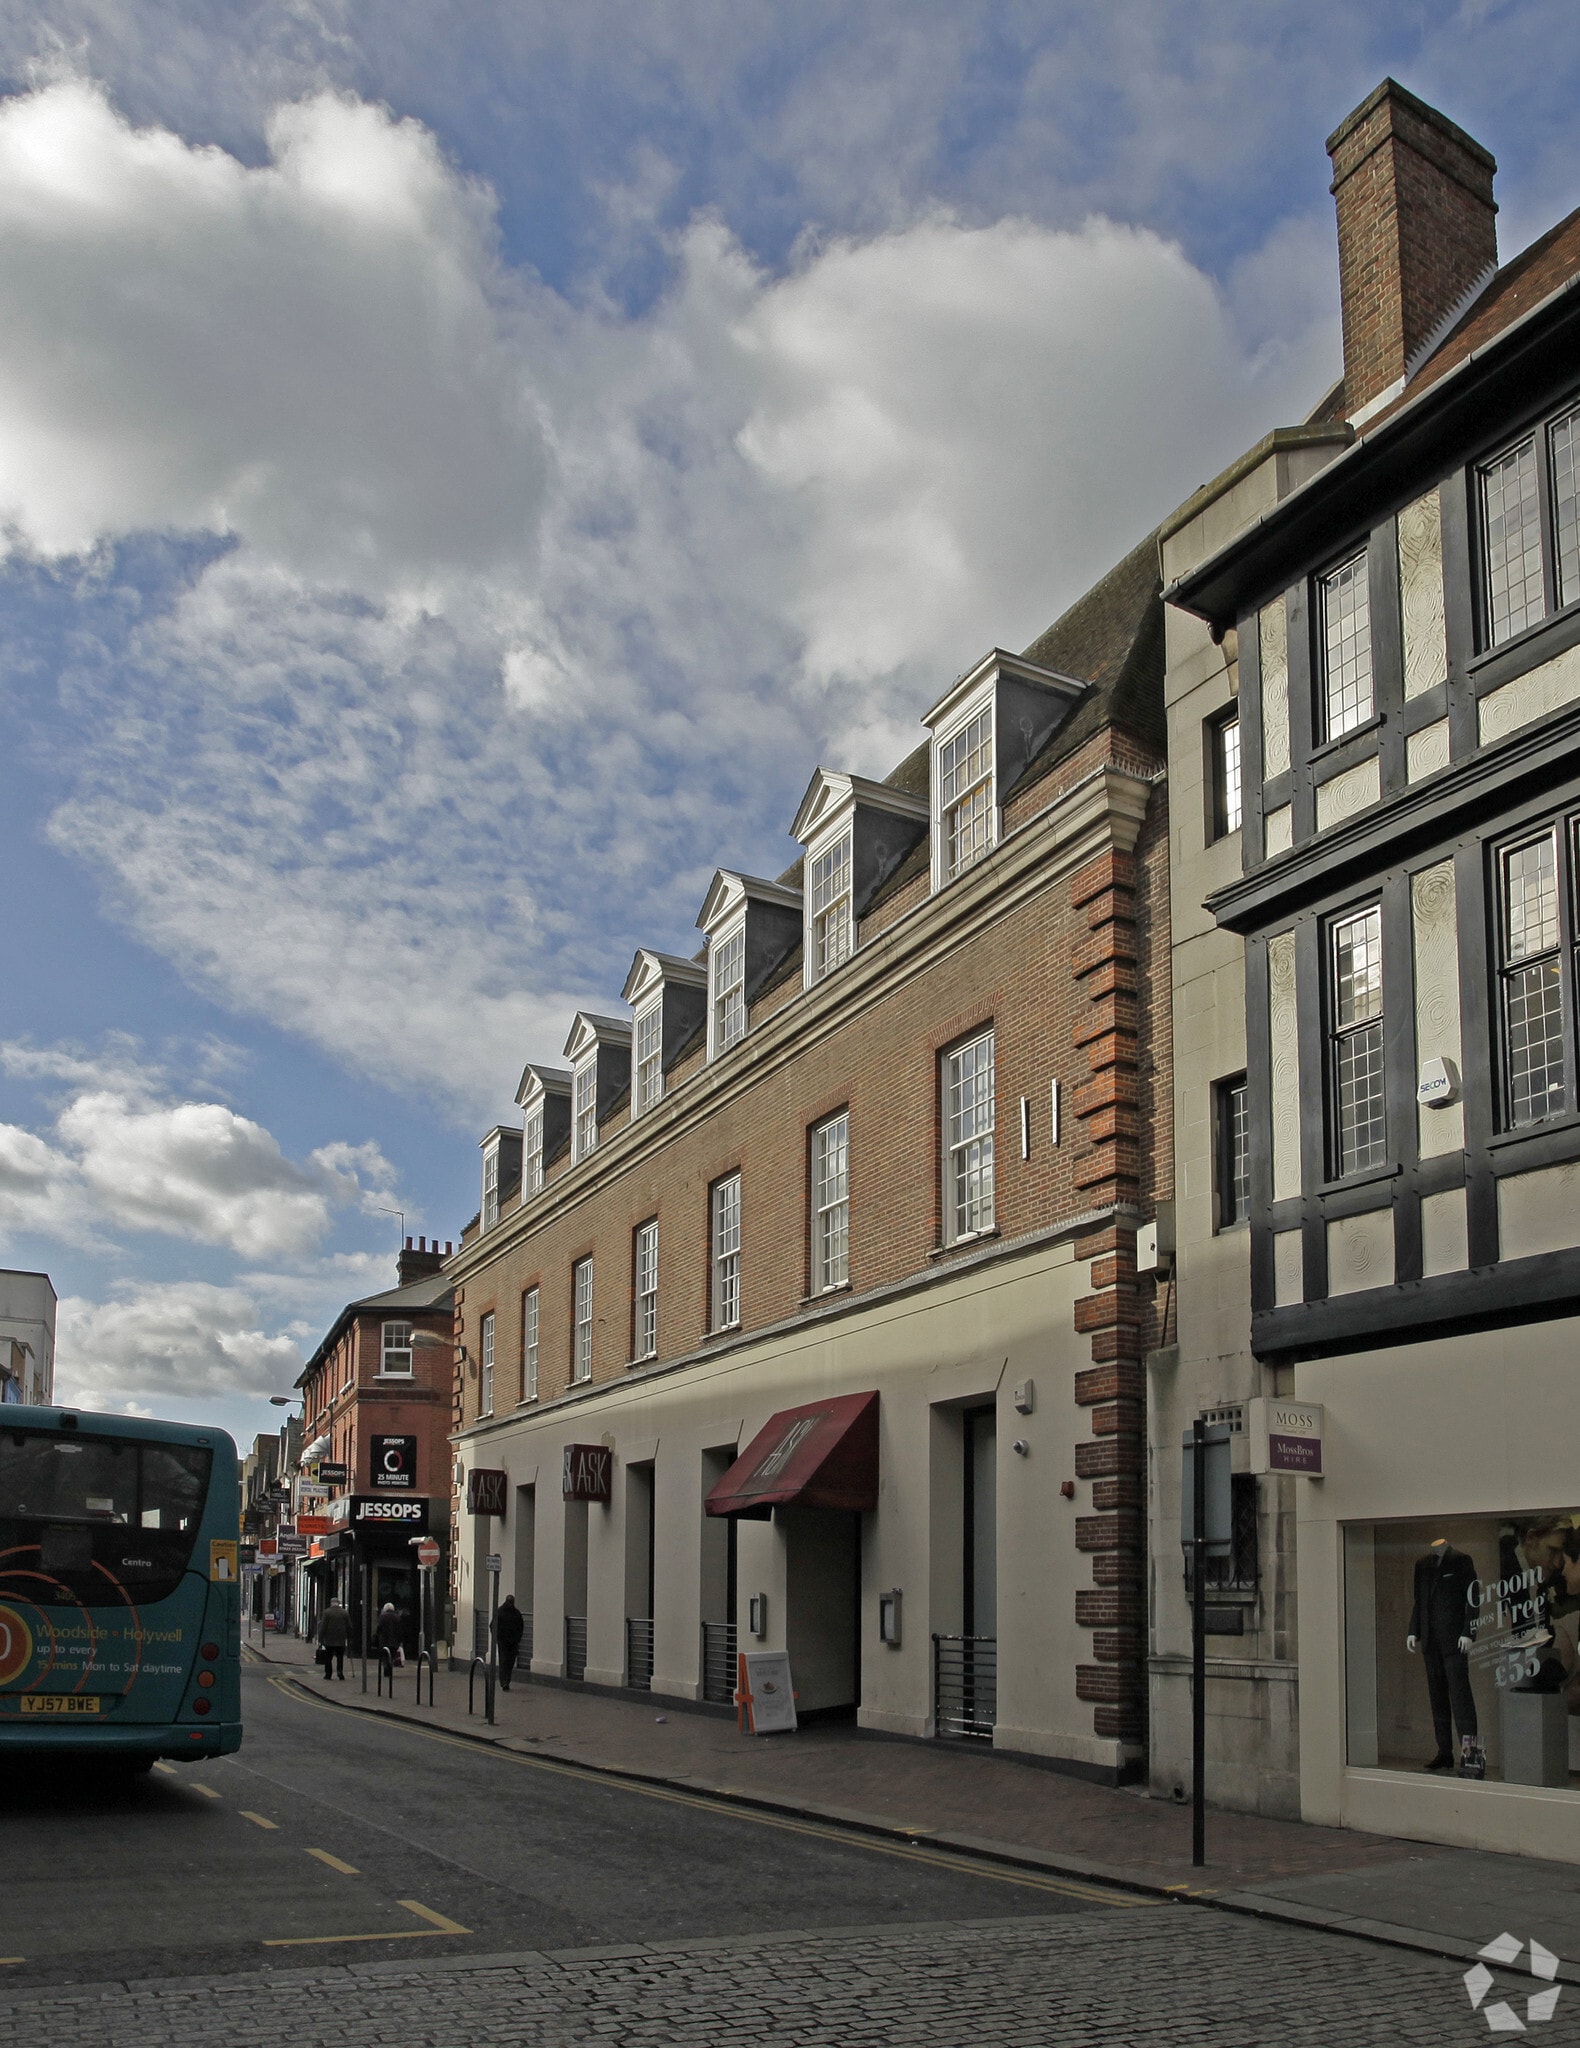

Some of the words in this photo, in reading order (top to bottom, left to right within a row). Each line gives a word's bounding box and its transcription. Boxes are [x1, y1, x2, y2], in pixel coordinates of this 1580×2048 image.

[1420, 1078, 1446, 1093] SECOM
[1276, 1411, 1313, 1428] MOSS
[383, 1438, 405, 1446] JESSOPS
[1284, 1456, 1307, 1465] HIRE
[377, 1473, 385, 1481] 25
[577, 1452, 607, 1494] ASK
[477, 1474, 503, 1510] ASK
[355, 1502, 422, 1520] JESSOPS
[121, 1558, 152, 1567] Centro
[1466, 1565, 1545, 1608] Groom
[1469, 1612, 1495, 1635] goes
[36, 1625, 108, 1640] Woodside
[123, 1628, 183, 1644] Holywell
[36, 1646, 51, 1655] up
[55, 1645, 66, 1654] to
[69, 1647, 98, 1657] every
[38, 1660, 48, 1670] 15
[52, 1661, 78, 1671] mins
[82, 1661, 106, 1671] Mon
[109, 1663, 120, 1672] to
[123, 1662, 139, 1672] Sat
[142, 1663, 183, 1675] daytime
[1494, 1648, 1541, 1687] £55
[27, 1698, 64, 1711] YJ57
[67, 1698, 95, 1711] BWE
